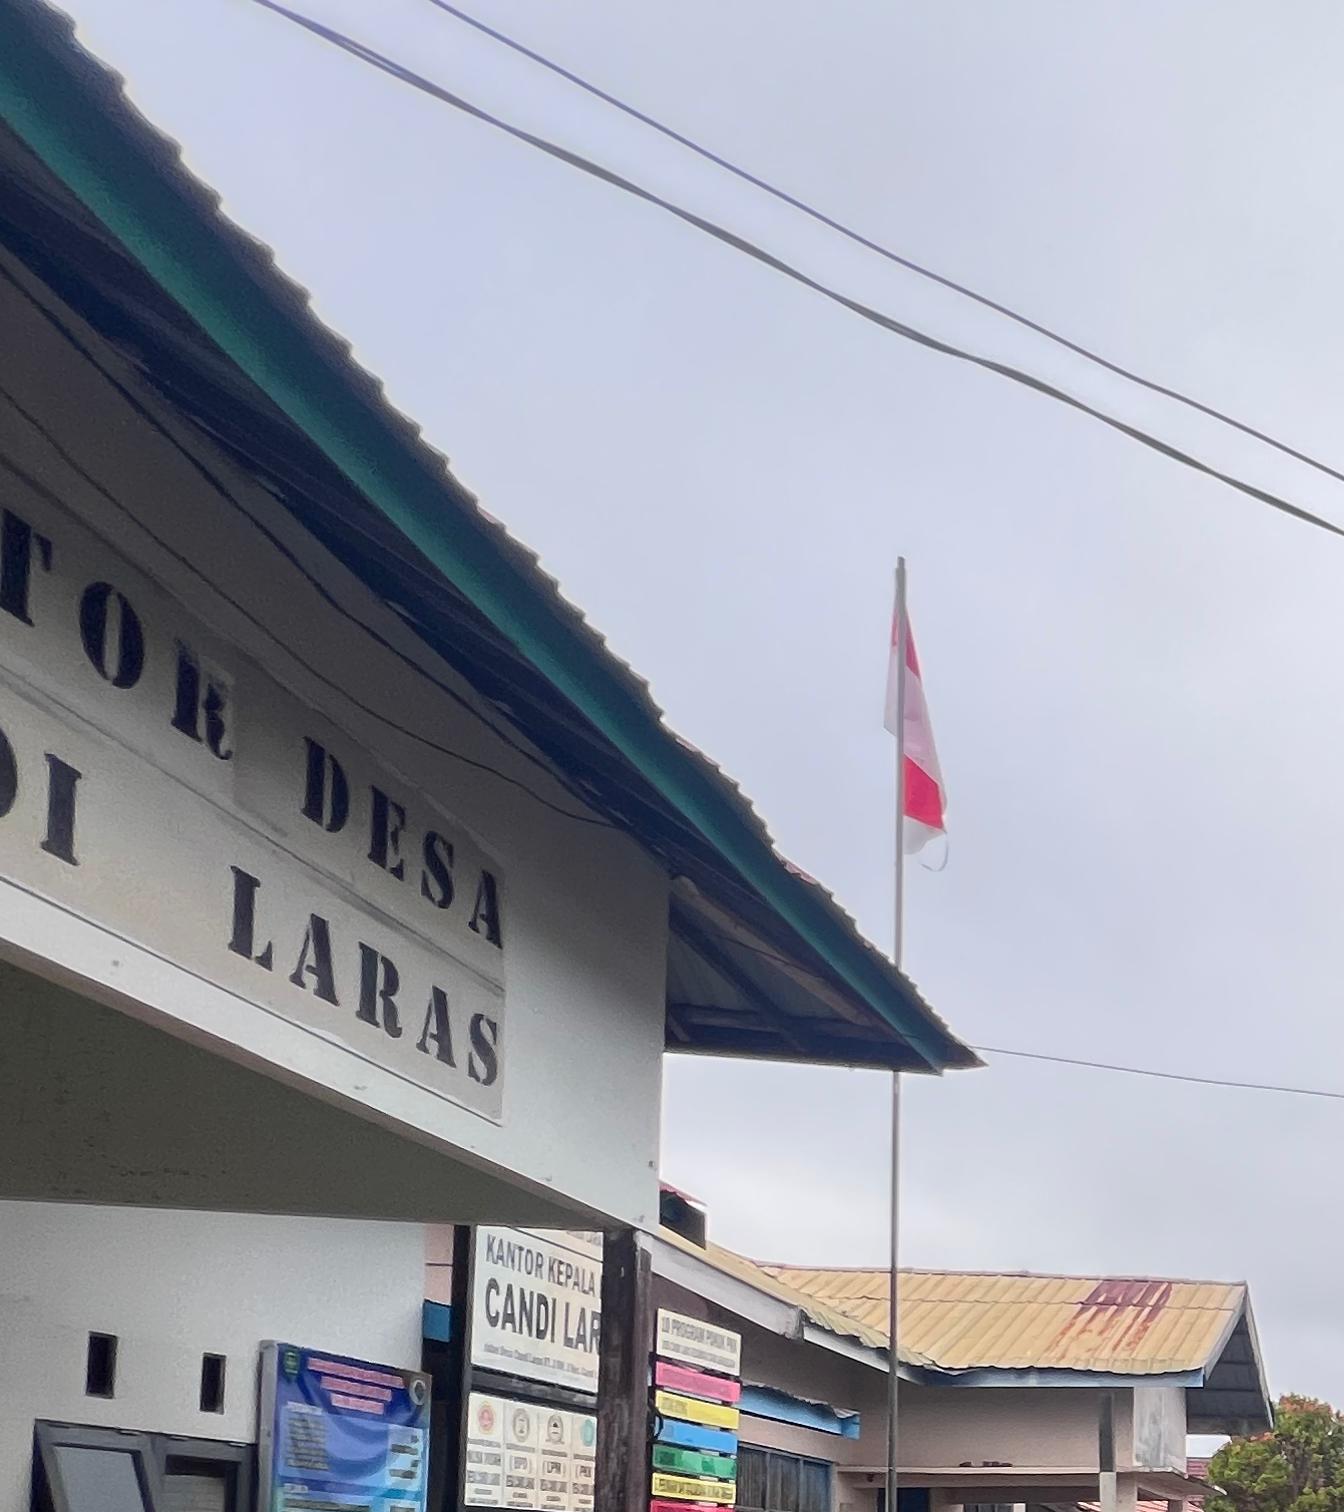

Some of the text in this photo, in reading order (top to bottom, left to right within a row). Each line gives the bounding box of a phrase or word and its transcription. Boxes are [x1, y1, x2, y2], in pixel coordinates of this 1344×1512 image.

[303, 735, 503, 950] DESA
[228, 864, 498, 1087] LARAS
[485, 1277, 556, 1343] CANDI
[486, 1233, 596, 1298] KANTOR KEPALA
